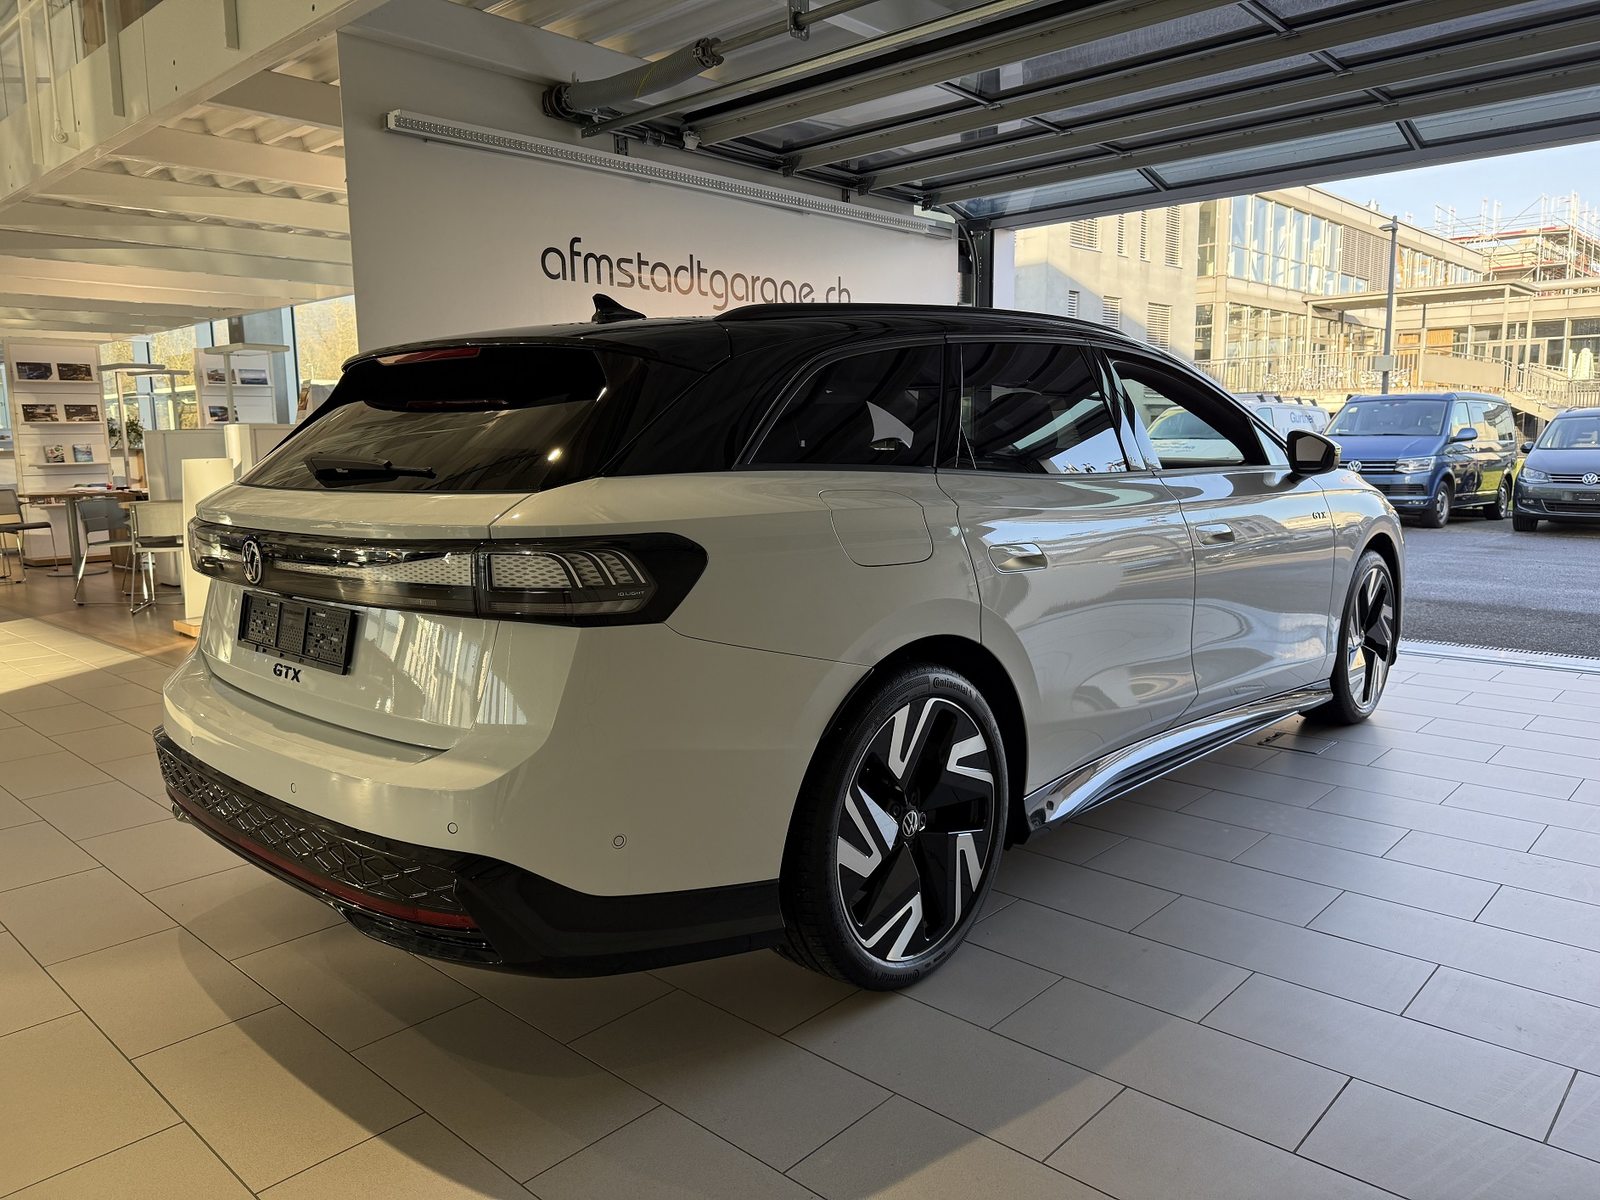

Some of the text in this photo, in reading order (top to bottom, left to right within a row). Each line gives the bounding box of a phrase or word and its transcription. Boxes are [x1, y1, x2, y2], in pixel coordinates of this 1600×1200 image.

[541, 236, 851, 311] afmstadtgaragech
[1311, 511, 1327, 519] GTX
[273, 663, 302, 683] GTX
[933, 676, 969, 696] Continental
